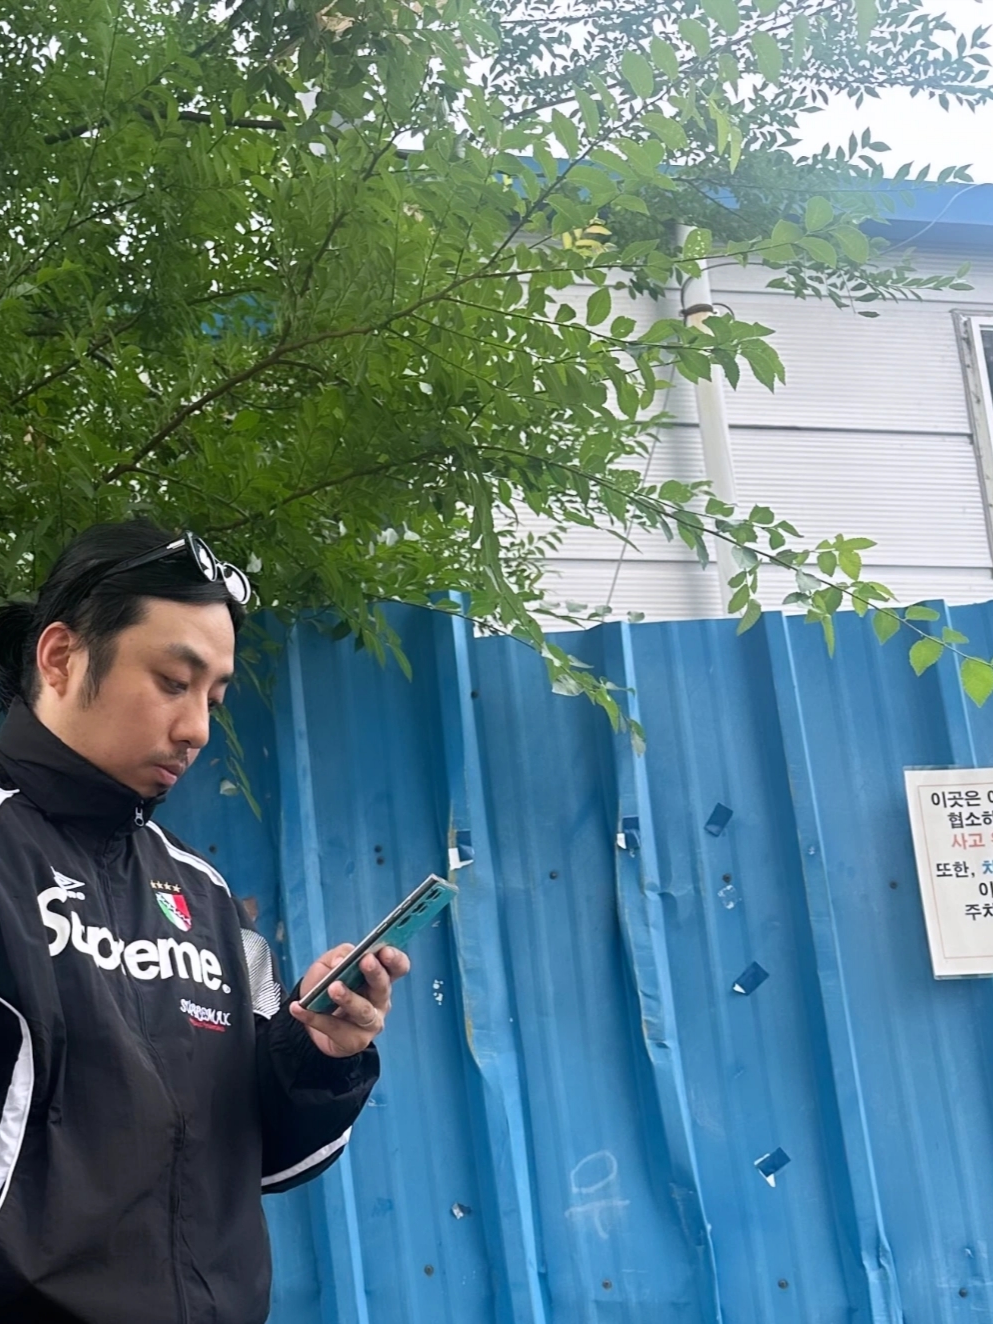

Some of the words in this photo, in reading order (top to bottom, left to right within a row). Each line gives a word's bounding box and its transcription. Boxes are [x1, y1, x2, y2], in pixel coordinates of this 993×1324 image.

[930, 790, 981, 808] 이곳은
[951, 832, 986, 850] 사고
[936, 861, 976, 878] 또한,
